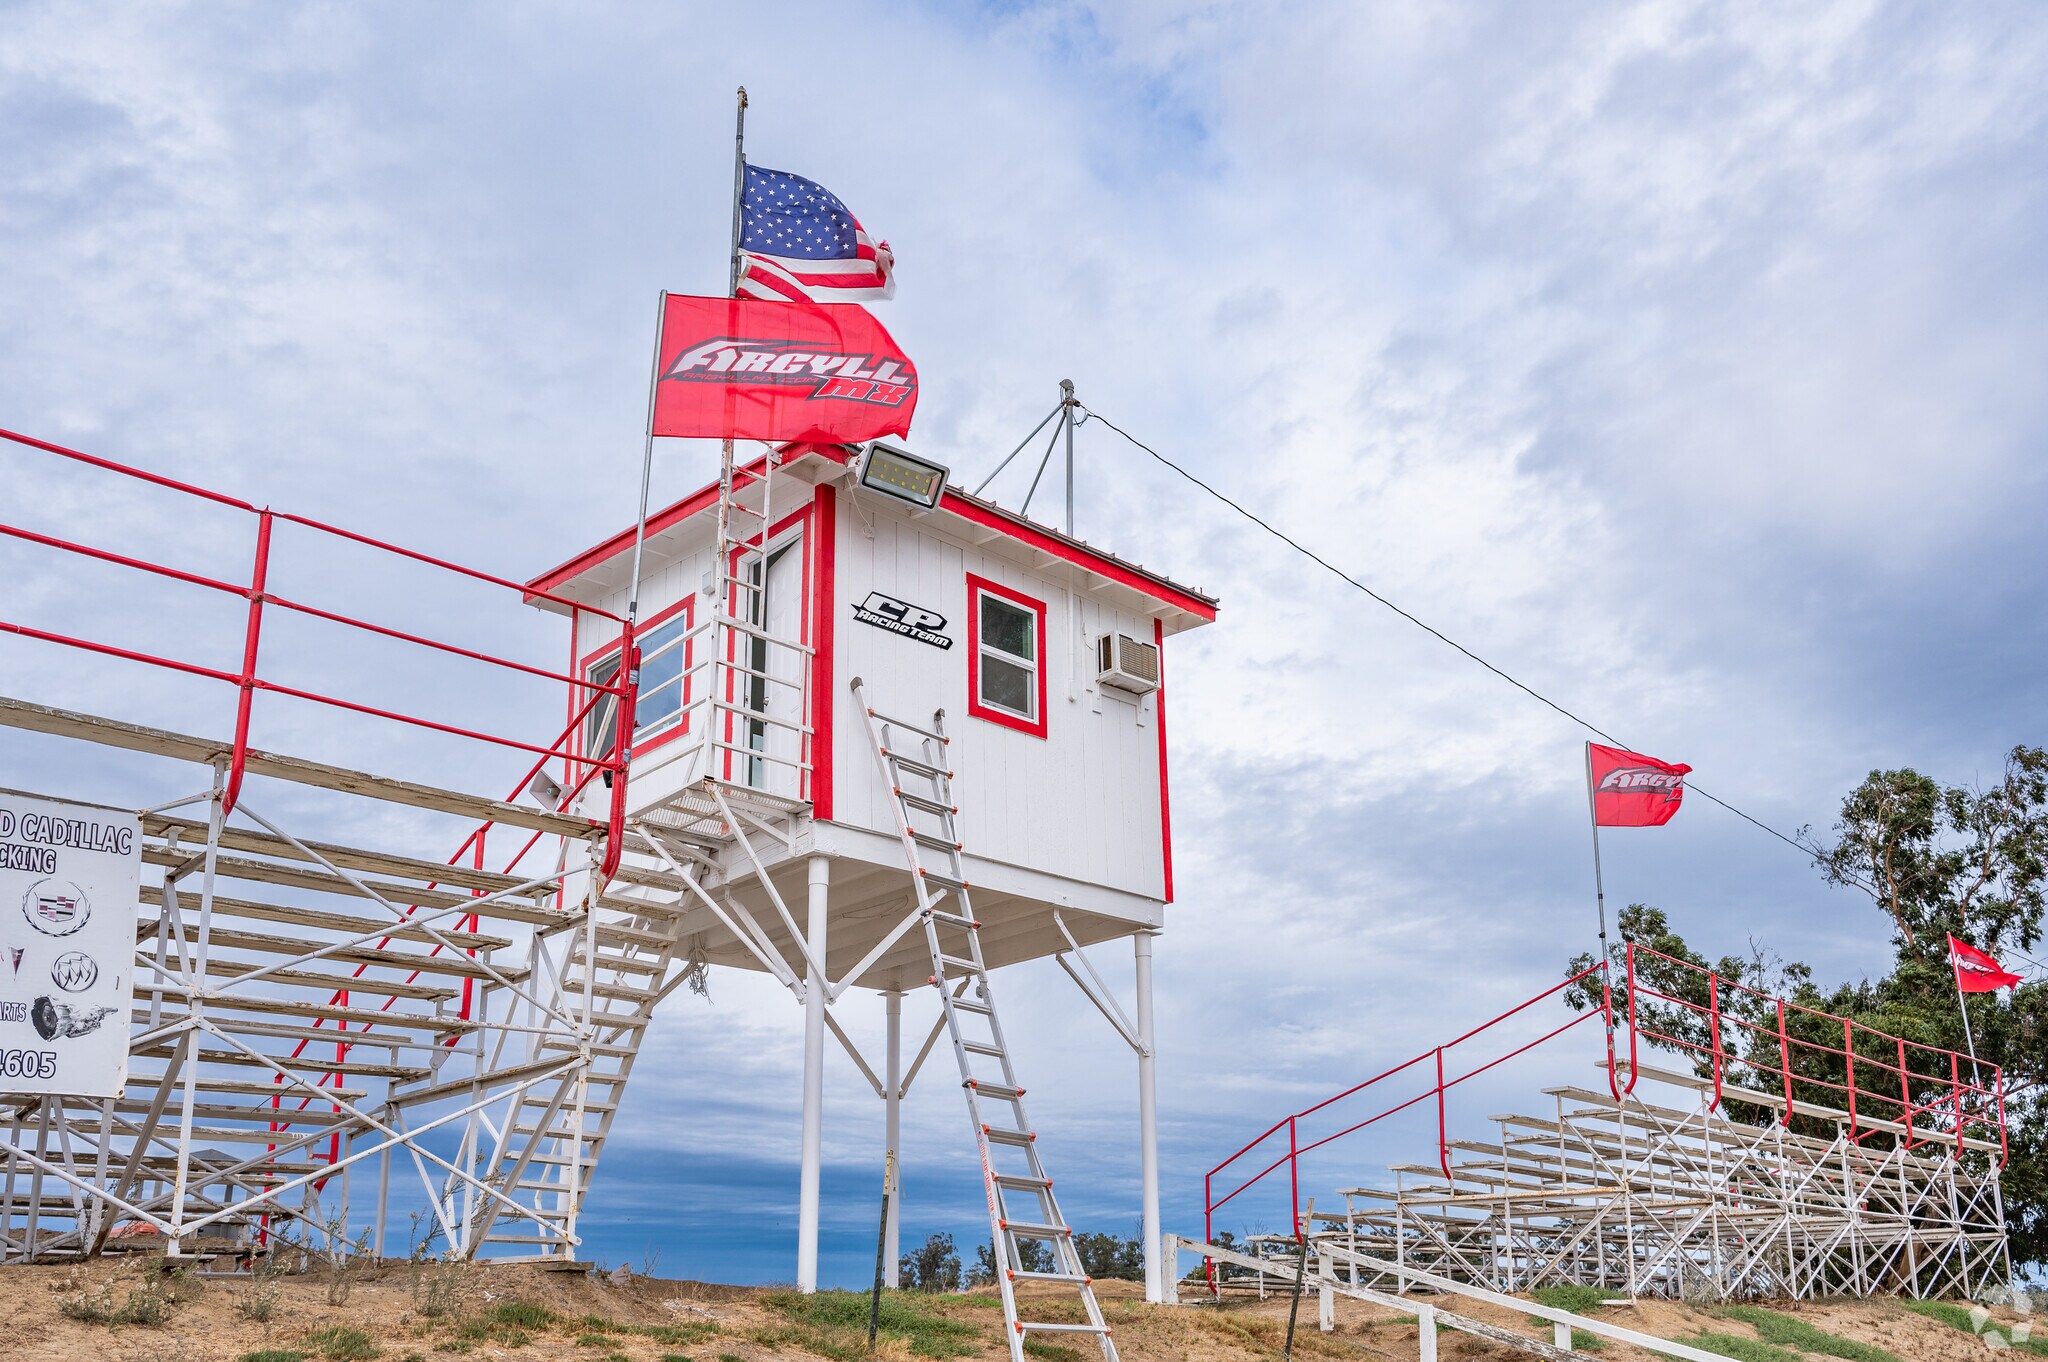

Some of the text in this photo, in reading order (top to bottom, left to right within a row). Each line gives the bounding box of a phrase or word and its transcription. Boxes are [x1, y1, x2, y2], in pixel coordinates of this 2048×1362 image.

[673, 340, 909, 385] ARGYLL
[682, 372, 819, 384] ARGYLLMX.COM
[812, 377, 911, 406] MX
[860, 591, 948, 630] CP
[856, 609, 950, 647] RACING TEAM
[1600, 769, 1683, 789] ARGY
[20, 812, 133, 856] CADILLAC
[0, 1001, 27, 1022] RTS
